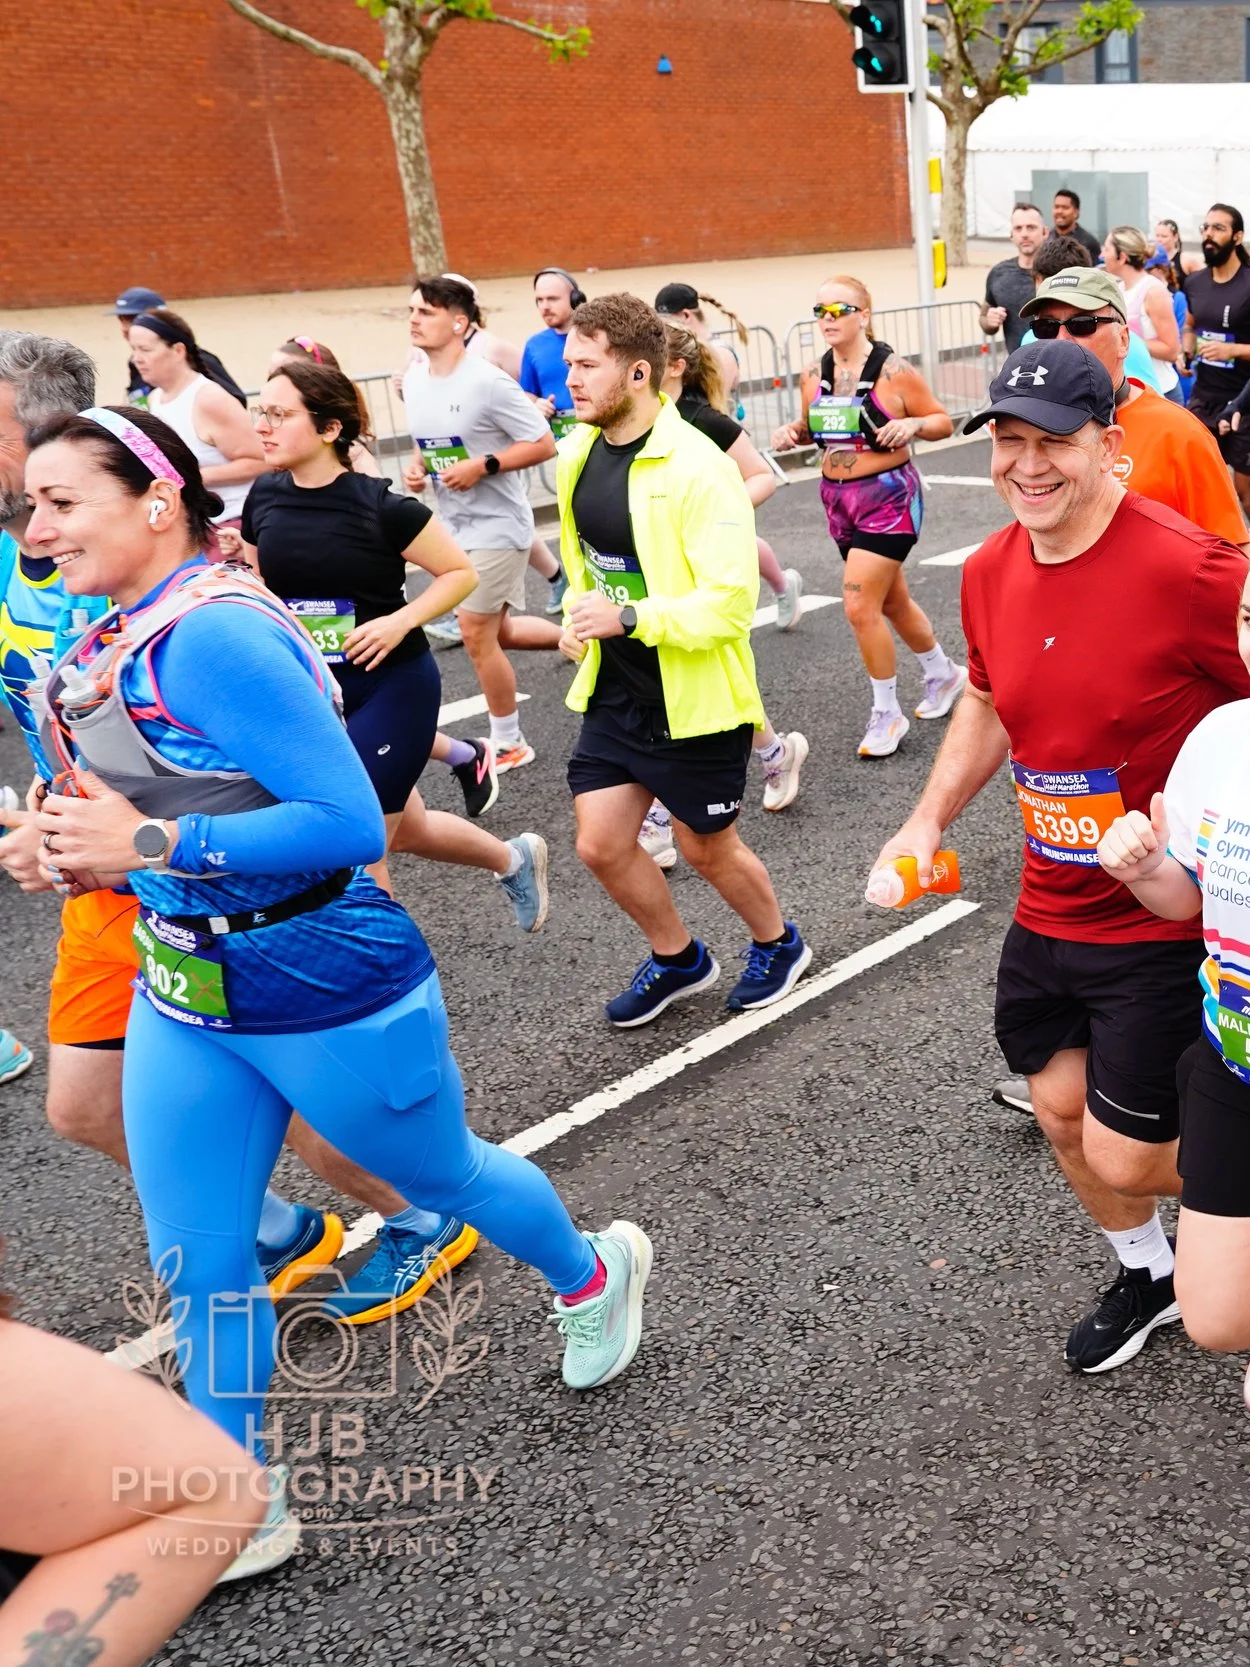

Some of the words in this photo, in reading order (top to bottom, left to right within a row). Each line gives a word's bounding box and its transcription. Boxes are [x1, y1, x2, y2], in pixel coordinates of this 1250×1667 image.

[822, 415, 846, 430] 292
[1043, 773, 1088, 784] SWANSEA
[1057, 783, 1089, 791] Marathon
[1018, 789, 1067, 814] JONATHAN
[1033, 810, 1100, 845] 5399
[1041, 845, 1100, 863] #RUNSWANSE
[146, 954, 190, 1004] 802
